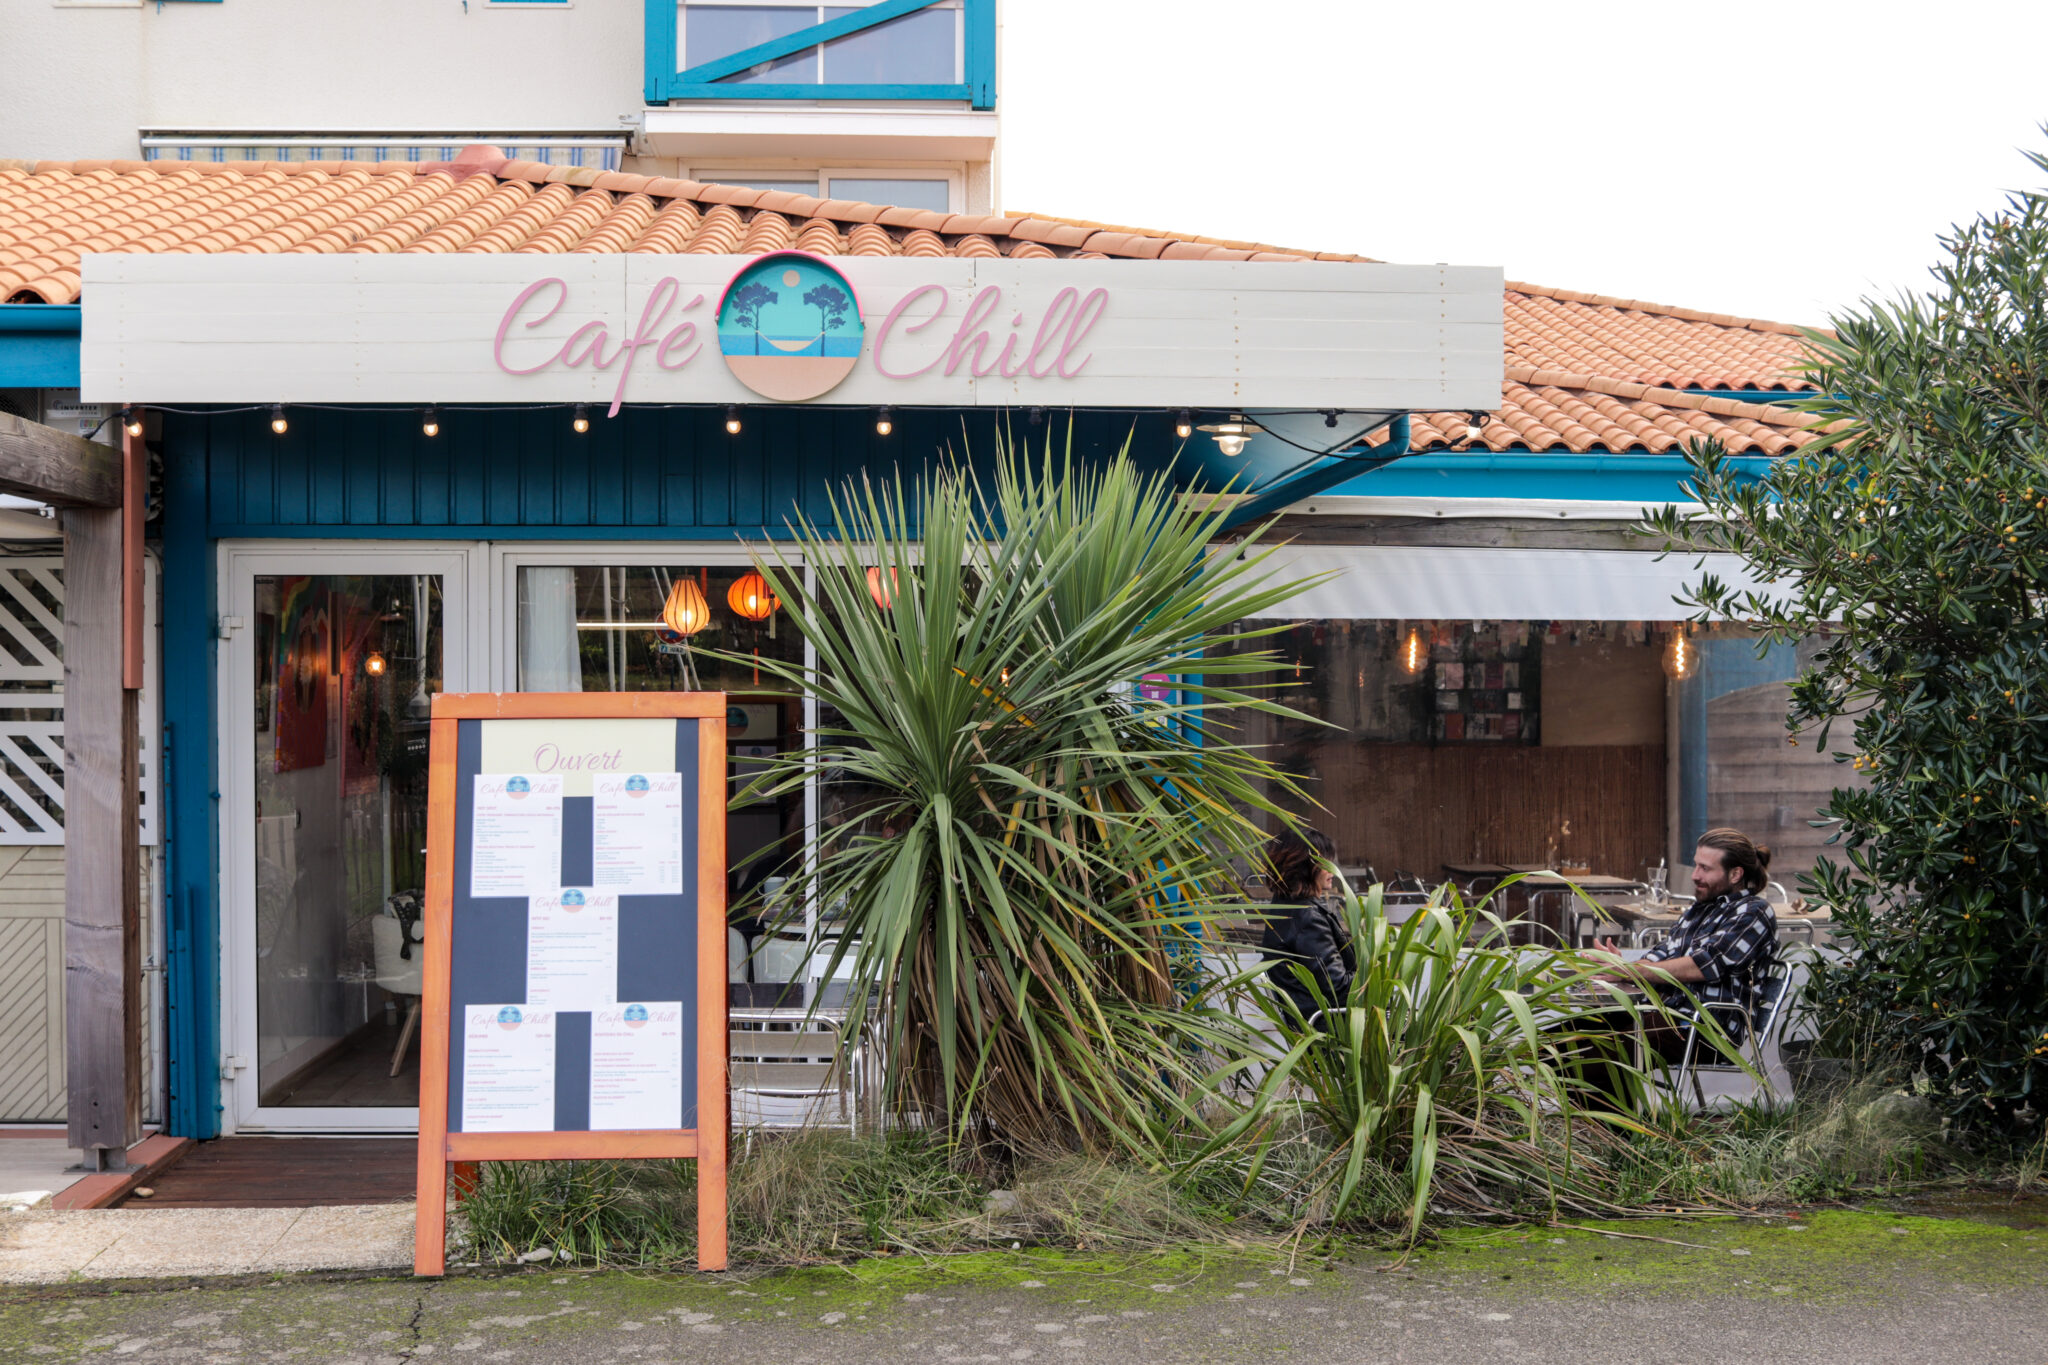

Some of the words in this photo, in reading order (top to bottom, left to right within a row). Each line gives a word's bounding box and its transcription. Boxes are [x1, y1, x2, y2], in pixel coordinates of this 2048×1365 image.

[494, 276, 705, 419] Café
[873, 284, 1109, 379] Chill
[534, 743, 622, 774] Ouvert
[530, 783, 559, 793] Chill
[649, 781, 679, 792] Chill
[585, 896, 615, 907] Chill
[522, 1012, 552, 1025] Chill
[648, 1011, 678, 1023] Chill
